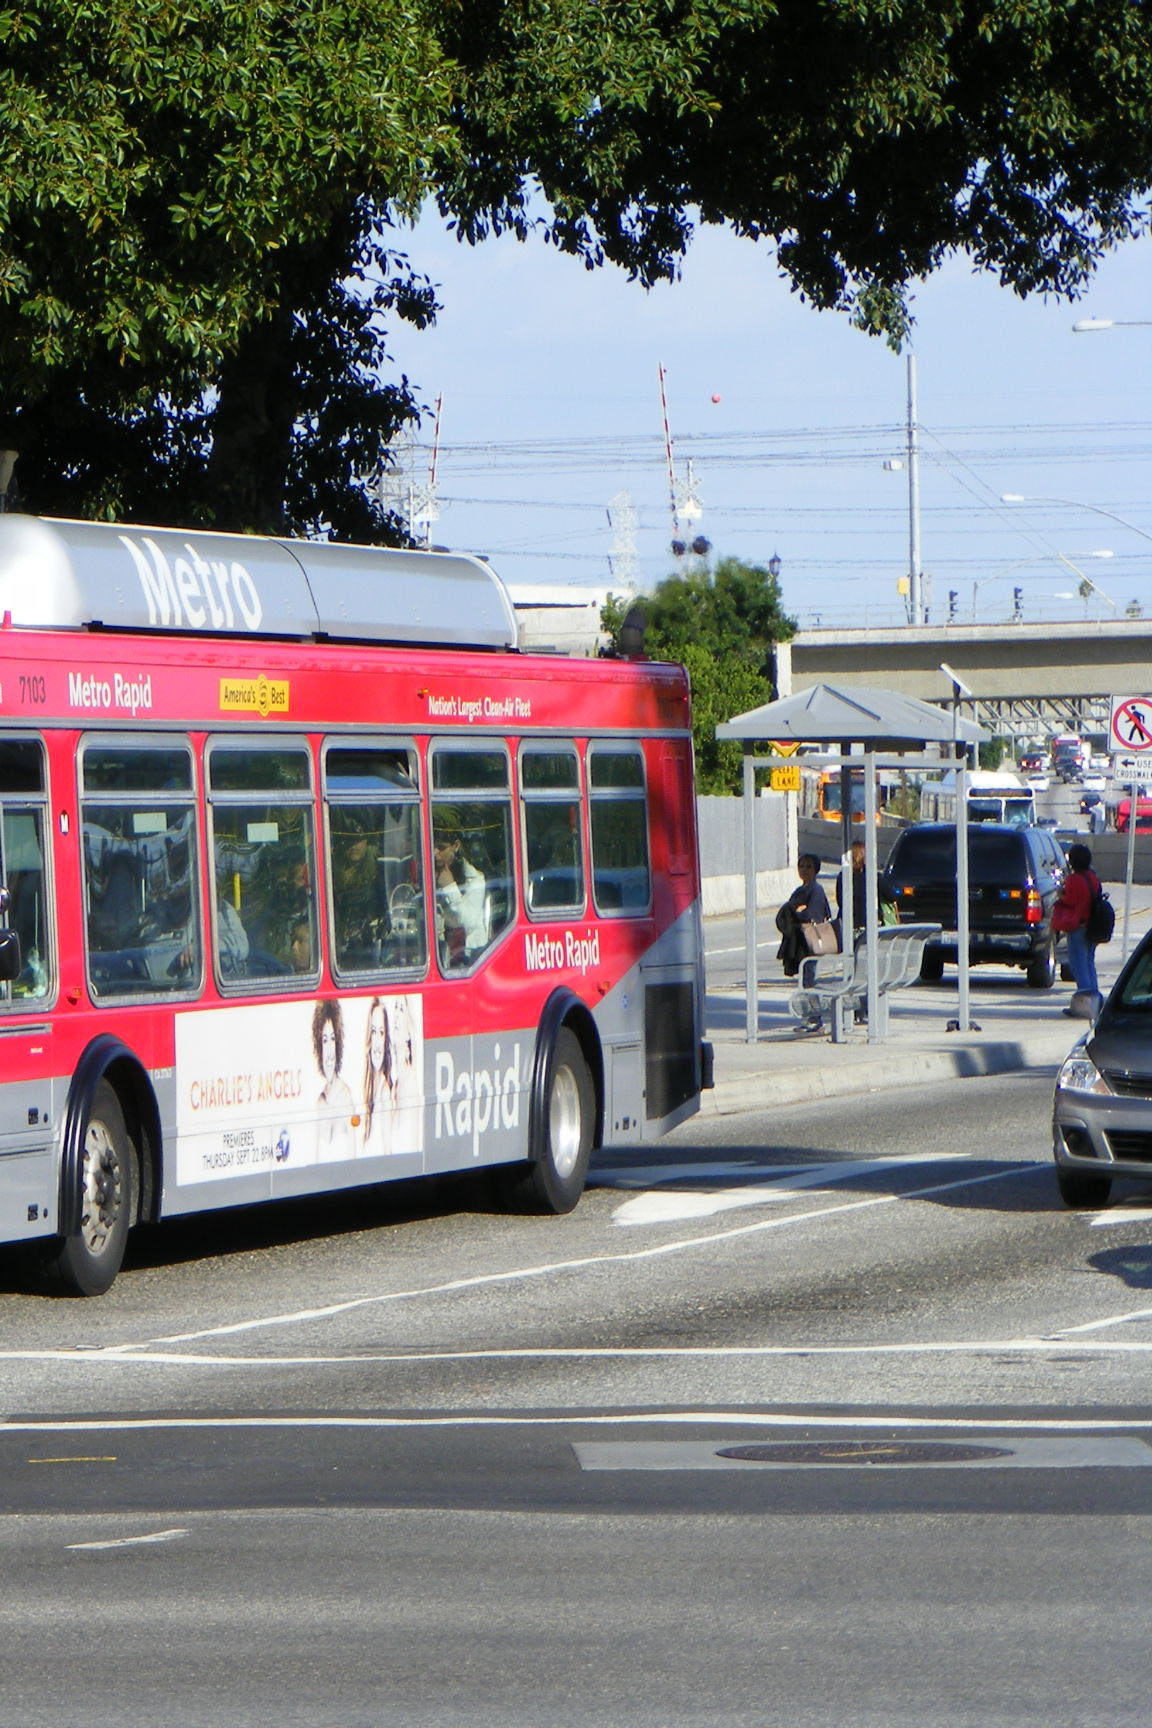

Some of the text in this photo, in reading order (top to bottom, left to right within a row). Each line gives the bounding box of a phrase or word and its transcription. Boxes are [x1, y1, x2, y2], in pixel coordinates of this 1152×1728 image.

[118, 534, 263, 631] Metro
[19, 676, 46, 704] 7103
[68, 672, 152, 717] Metro Rapid
[224, 685, 285, 704] America's Best
[458, 696, 482, 722] Largest
[1116, 769, 1152, 780] CROSSWAL
[525, 929, 600, 976] Metro Rapid
[190, 1069, 302, 1110] CHARLIE'S ANGELS
[435, 1043, 520, 1157] Rapid
[223, 1130, 254, 1148] PREMIERES
[203, 1150, 234, 1169] THURSDAY
